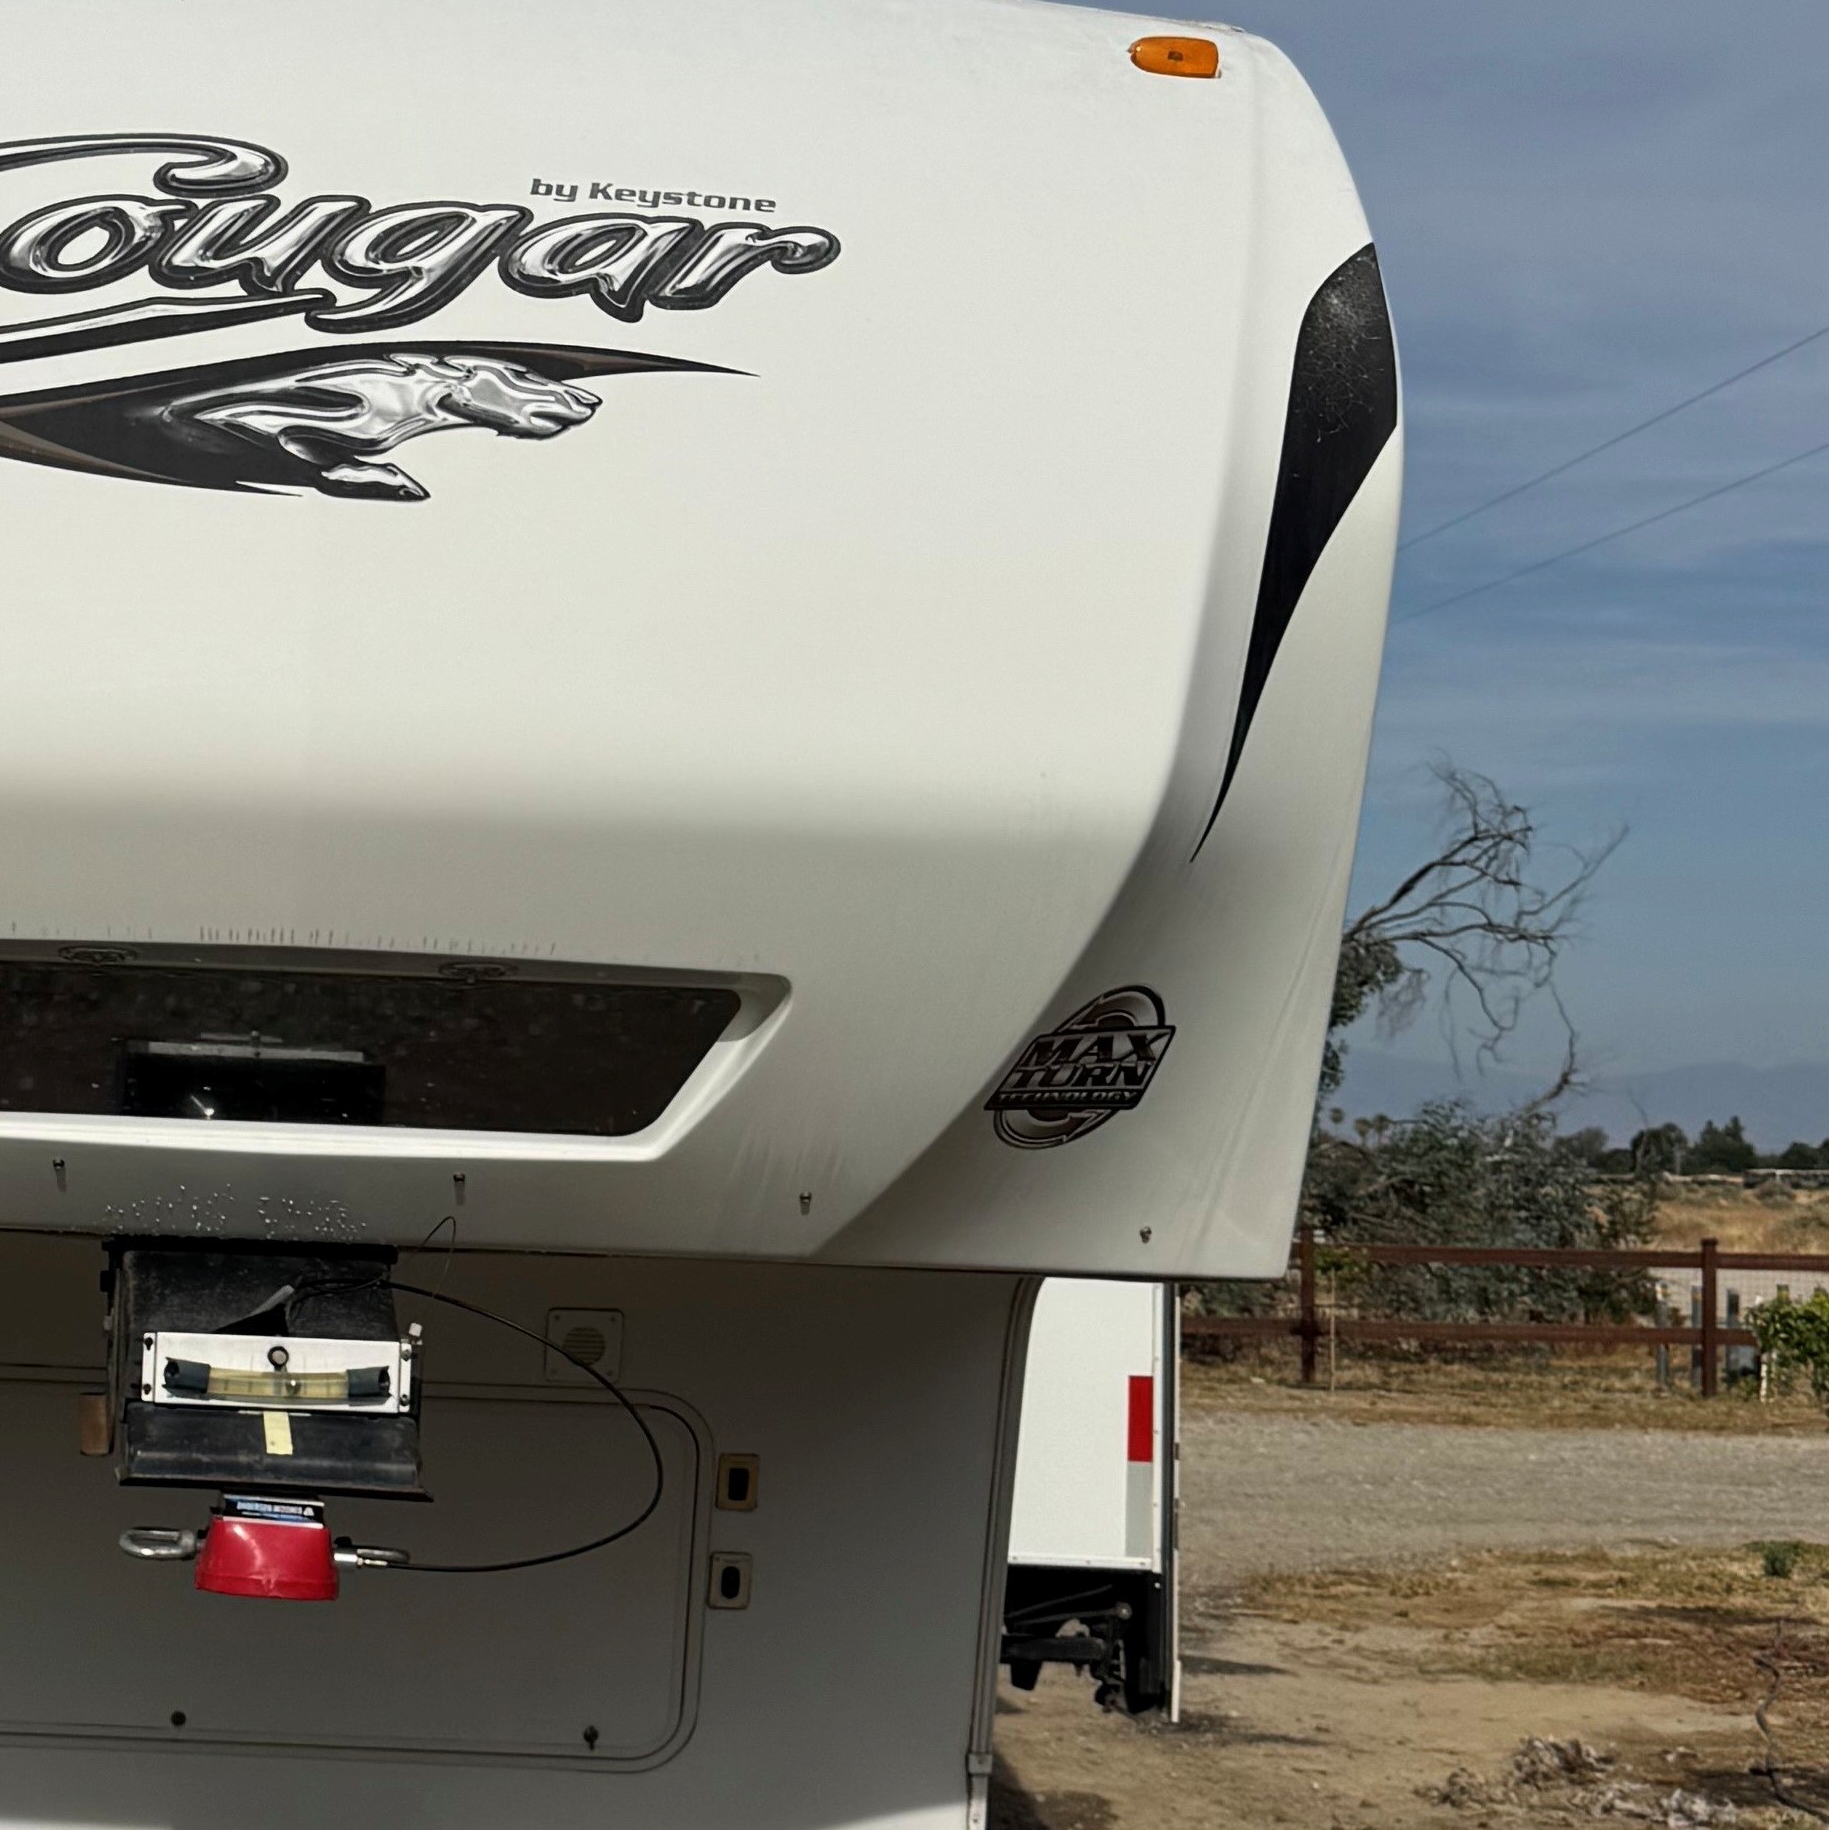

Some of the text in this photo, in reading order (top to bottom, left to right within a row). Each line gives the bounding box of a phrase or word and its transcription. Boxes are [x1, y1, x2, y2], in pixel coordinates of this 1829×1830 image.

[530, 178, 777, 213] by Keystone
[1019, 1032, 1170, 1067] MAX
[1010, 1063, 1151, 1088] TURN
[999, 1091, 1137, 1102] TECHNOLOGY
